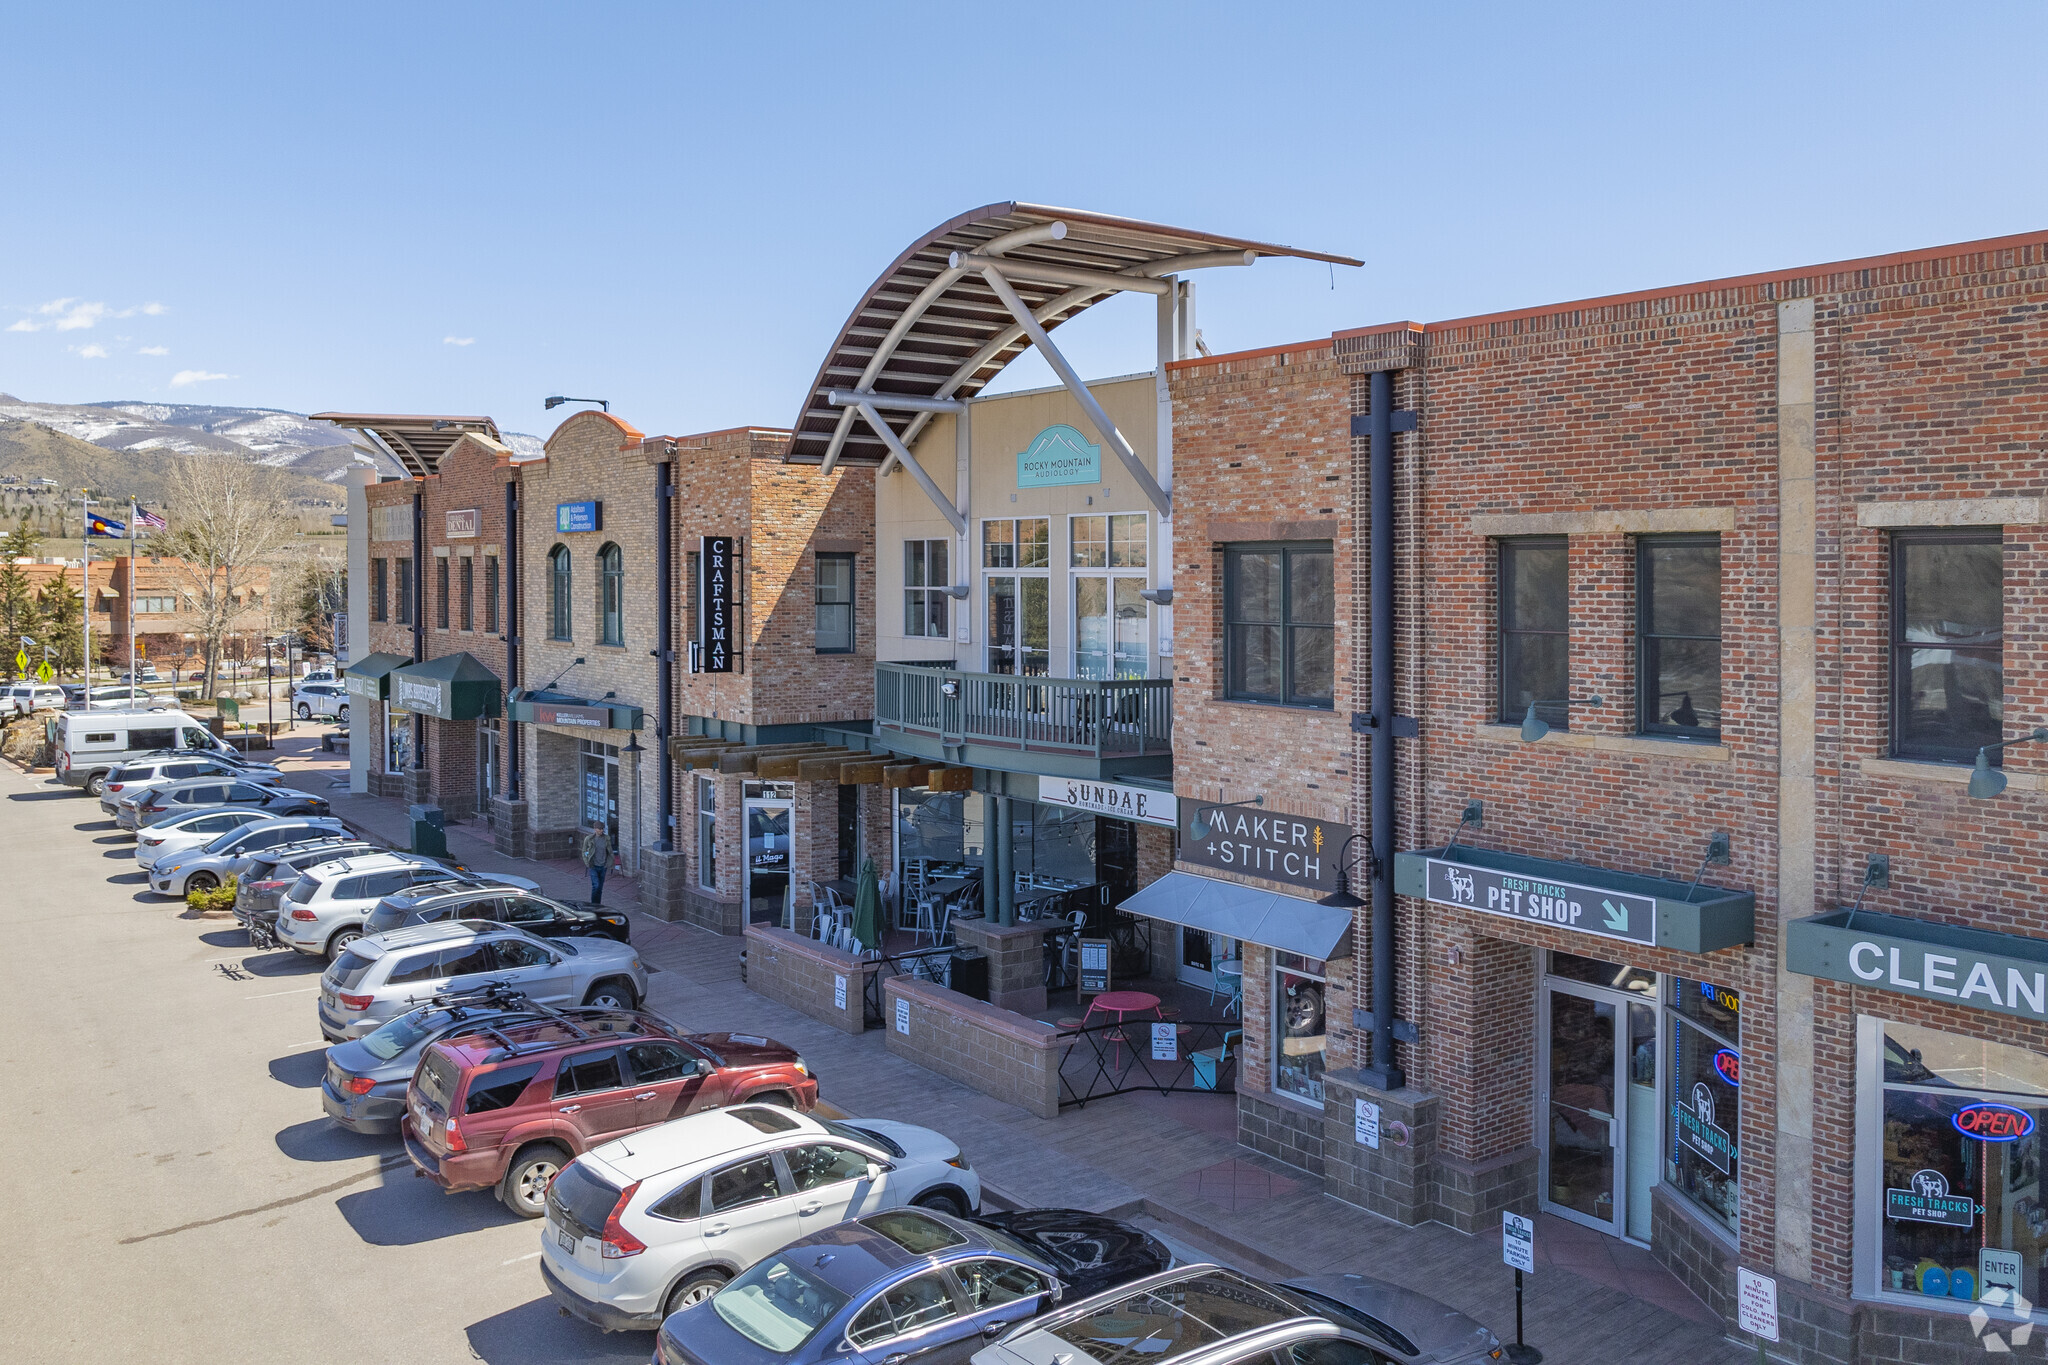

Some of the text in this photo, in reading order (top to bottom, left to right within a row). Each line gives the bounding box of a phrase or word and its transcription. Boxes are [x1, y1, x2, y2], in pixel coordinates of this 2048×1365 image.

[1024, 457, 1091, 471] ROCKY MOUNTAIN
[1035, 468, 1079, 478] AUDIOLOGY
[447, 520, 474, 532] DENTAL
[712, 540, 725, 669] CRAFTSMAN
[577, 719, 601, 727] PROPERTIES
[763, 790, 776, 799] 112
[1067, 781, 1147, 817] SUNDAE
[1079, 800, 1134, 816] HOMEMADE ICE CREAM
[1209, 809, 1308, 847] MAKER
[1502, 876, 1566, 899] FRESH TRACKS
[1488, 886, 1582, 925] PET SHOP
[1849, 941, 2046, 1014] CLEAN
[1700, 981, 1714, 1000] PET
[1717, 1053, 1739, 1080] OPE
[1957, 1109, 2027, 1136] OPEN
[1680, 1110, 1727, 1153] FRESH TRACKS
[1692, 1133, 1714, 1155] PET SHOP
[1891, 1194, 1968, 1213] FRESH TRACKS
[1912, 1207, 1947, 1218] PET SHOP
[1506, 1248, 1530, 1262] PARKING
[1507, 1242, 1529, 1255] MINUTE
[1511, 1256, 1525, 1266] ONLY
[1985, 1260, 2016, 1275] ENTER
[1745, 1284, 1769, 1297] MINUTE
[1753, 1279, 1762, 1288] 10
[1743, 1290, 1771, 1305] PARKING
[1751, 1300, 1764, 1309] FOR
[1742, 1310, 1774, 1327] CLEANERS
[1761, 1311, 1775, 1320] MTN
[1750, 1320, 1766, 1331] ONLY
